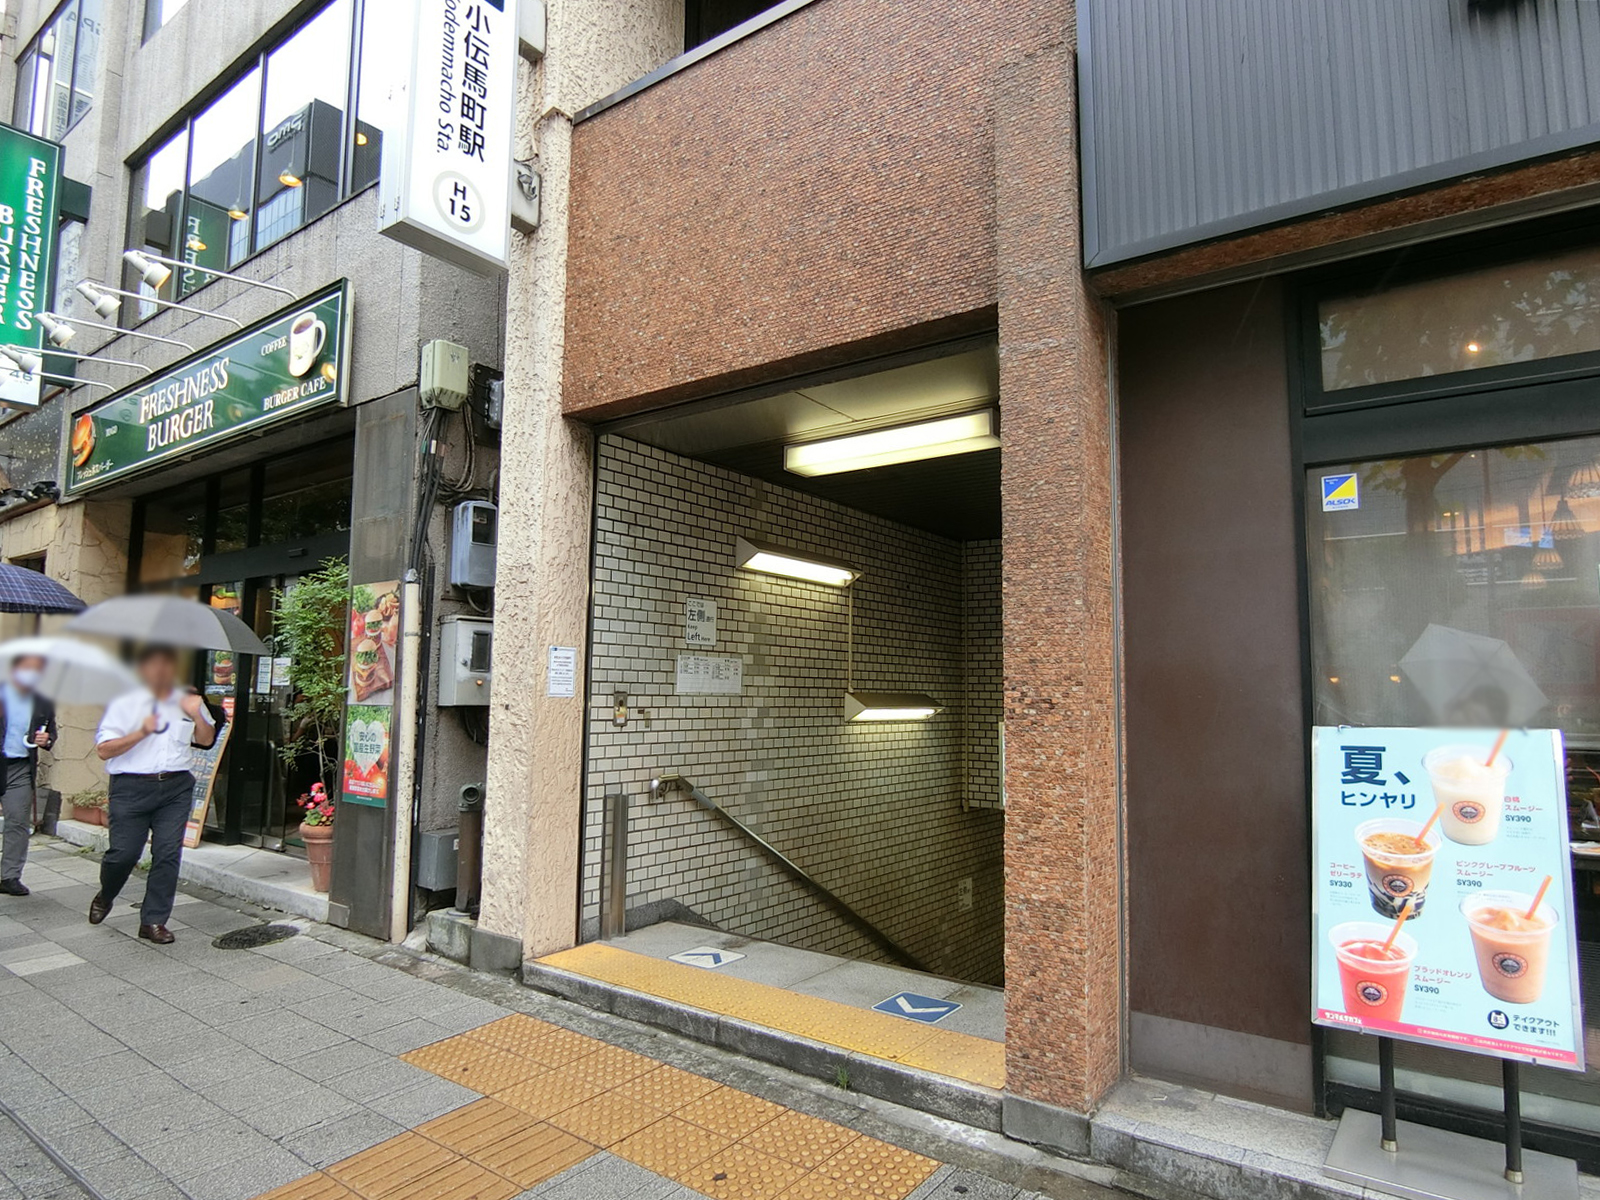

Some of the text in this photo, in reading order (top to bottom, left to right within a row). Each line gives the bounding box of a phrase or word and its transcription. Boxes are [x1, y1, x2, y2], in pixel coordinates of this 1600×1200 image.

[437, 0, 461, 154] odemmacho Sta.
[459, 4, 491, 163] 小伝馬町駅
[454, 181, 467, 201] H
[449, 197, 472, 223] 15
[15, 157, 46, 331] FRESHNESS
[260, 335, 288, 357] COFFEE
[138, 356, 230, 425] FRESHNESS
[262, 374, 327, 412] BURGER CAFE
[146, 398, 214, 452] BURGER
[1325, 498, 1355, 506] ALSOK
[688, 600, 704, 608] ここでは
[687, 632, 701, 641] Left
[1340, 745, 1411, 786] 夏、
[1341, 791, 1416, 809] ヒンヤリ
[1505, 804, 1544, 812] スムージー
[1330, 862, 1356, 870] コーヒー
[1330, 870, 1362, 879] ゼリーラテ
[1456, 868, 1494, 877] スムージー
[1414, 965, 1472, 979] ブラッドオレンジ
[1414, 974, 1451, 984] スムージー
[1513, 1014, 1560, 1027] テイクアウト
